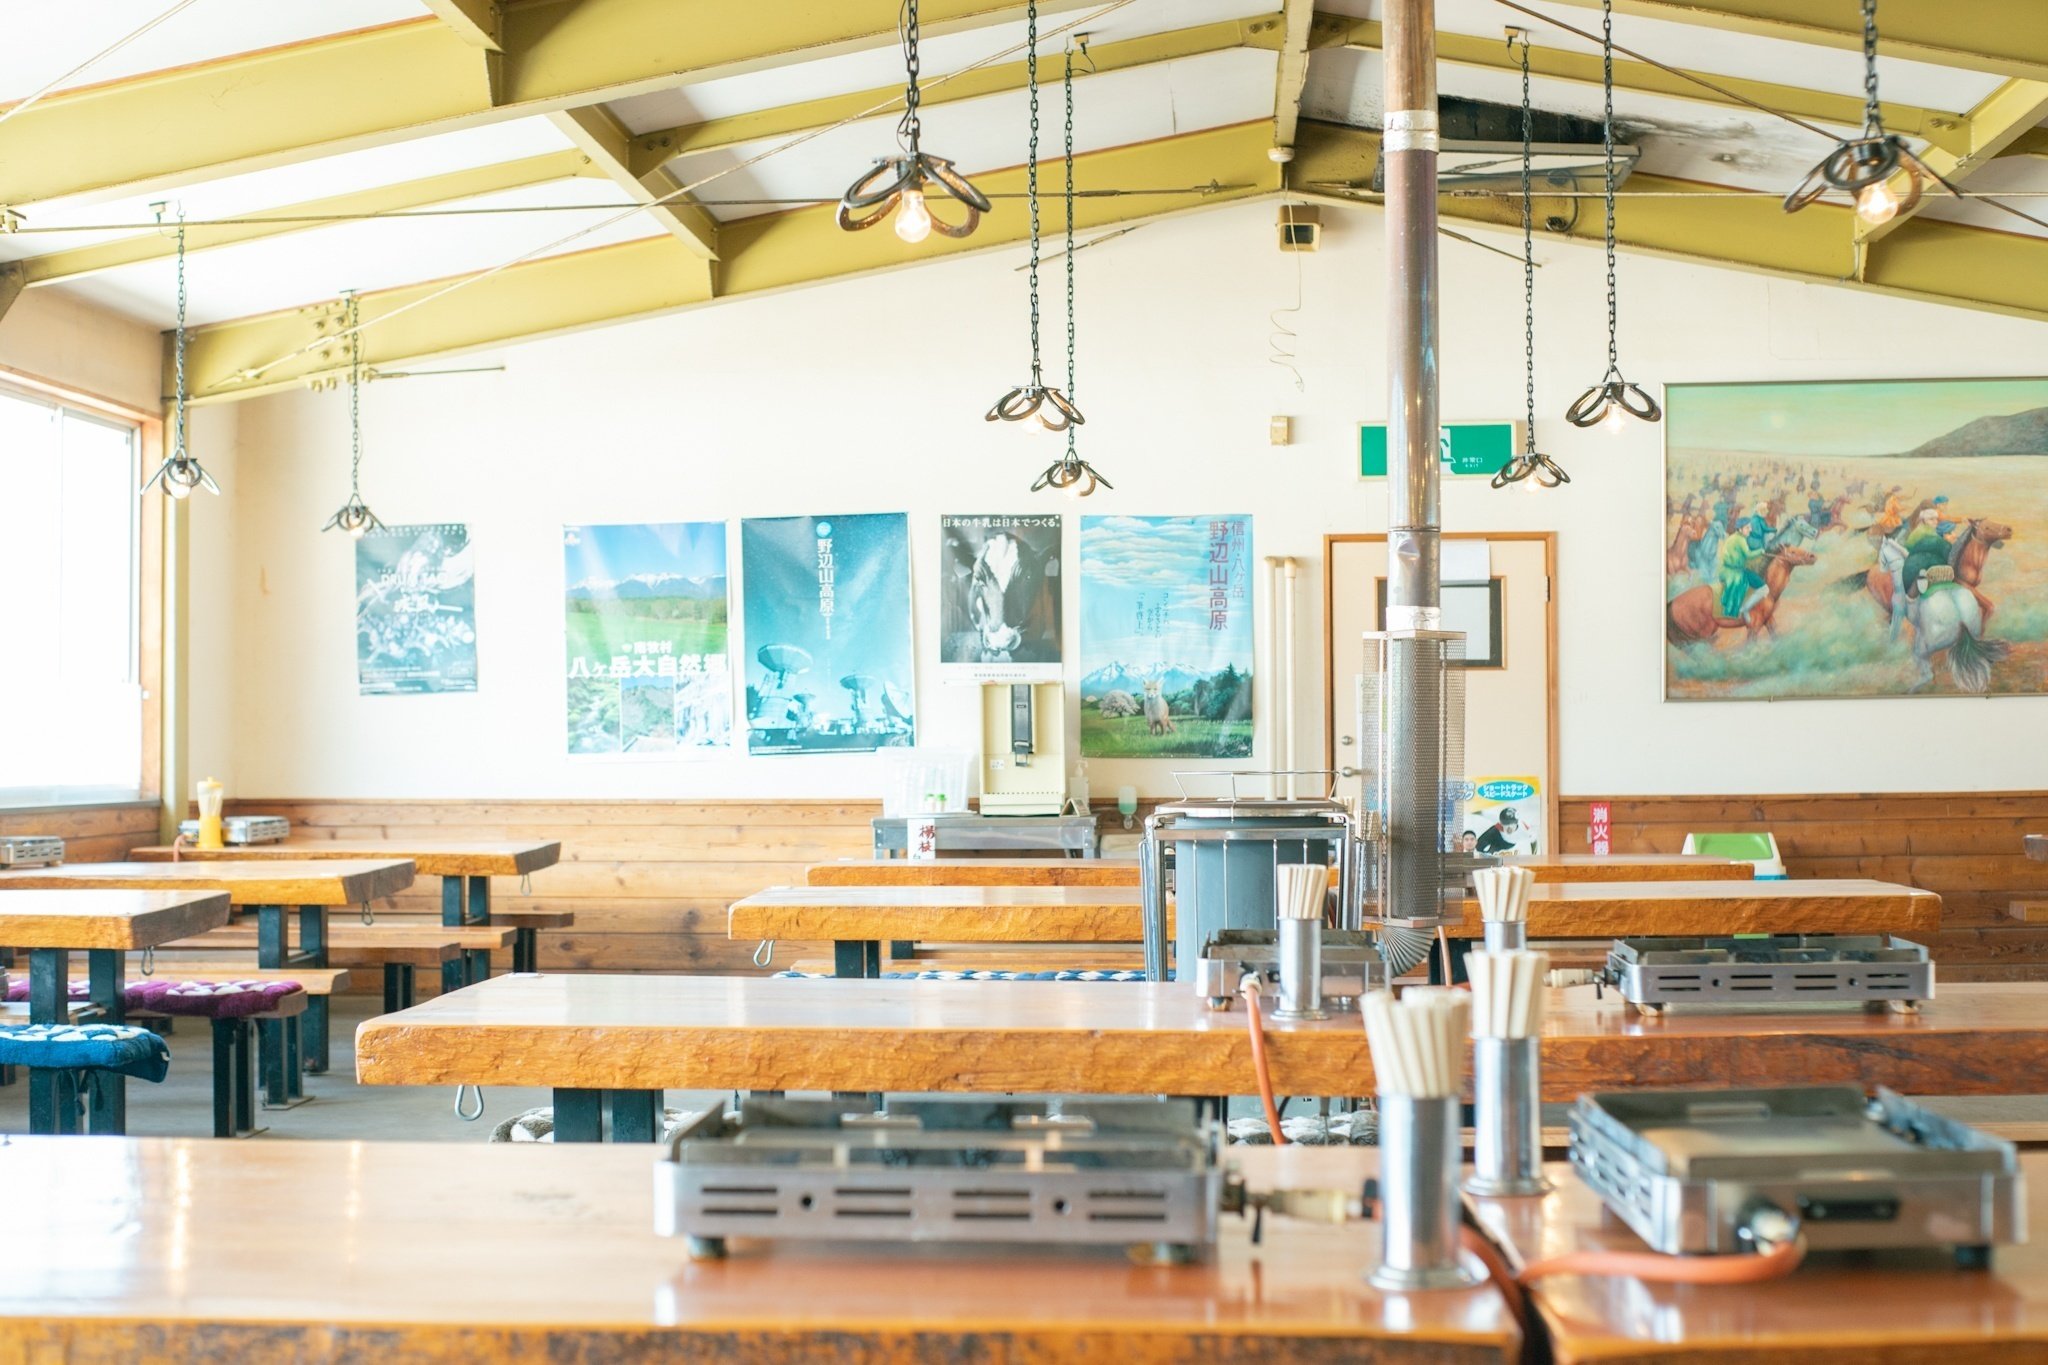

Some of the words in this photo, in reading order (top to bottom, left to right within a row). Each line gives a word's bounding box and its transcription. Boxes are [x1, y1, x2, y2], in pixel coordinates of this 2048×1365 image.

[943, 517, 1060, 528] 日本の牛乳は日本でつくる。
[817, 538, 834, 613] 野辺山高原
[1209, 520, 1228, 631] 野辺山高原
[1593, 807, 1609, 856] 消火器
